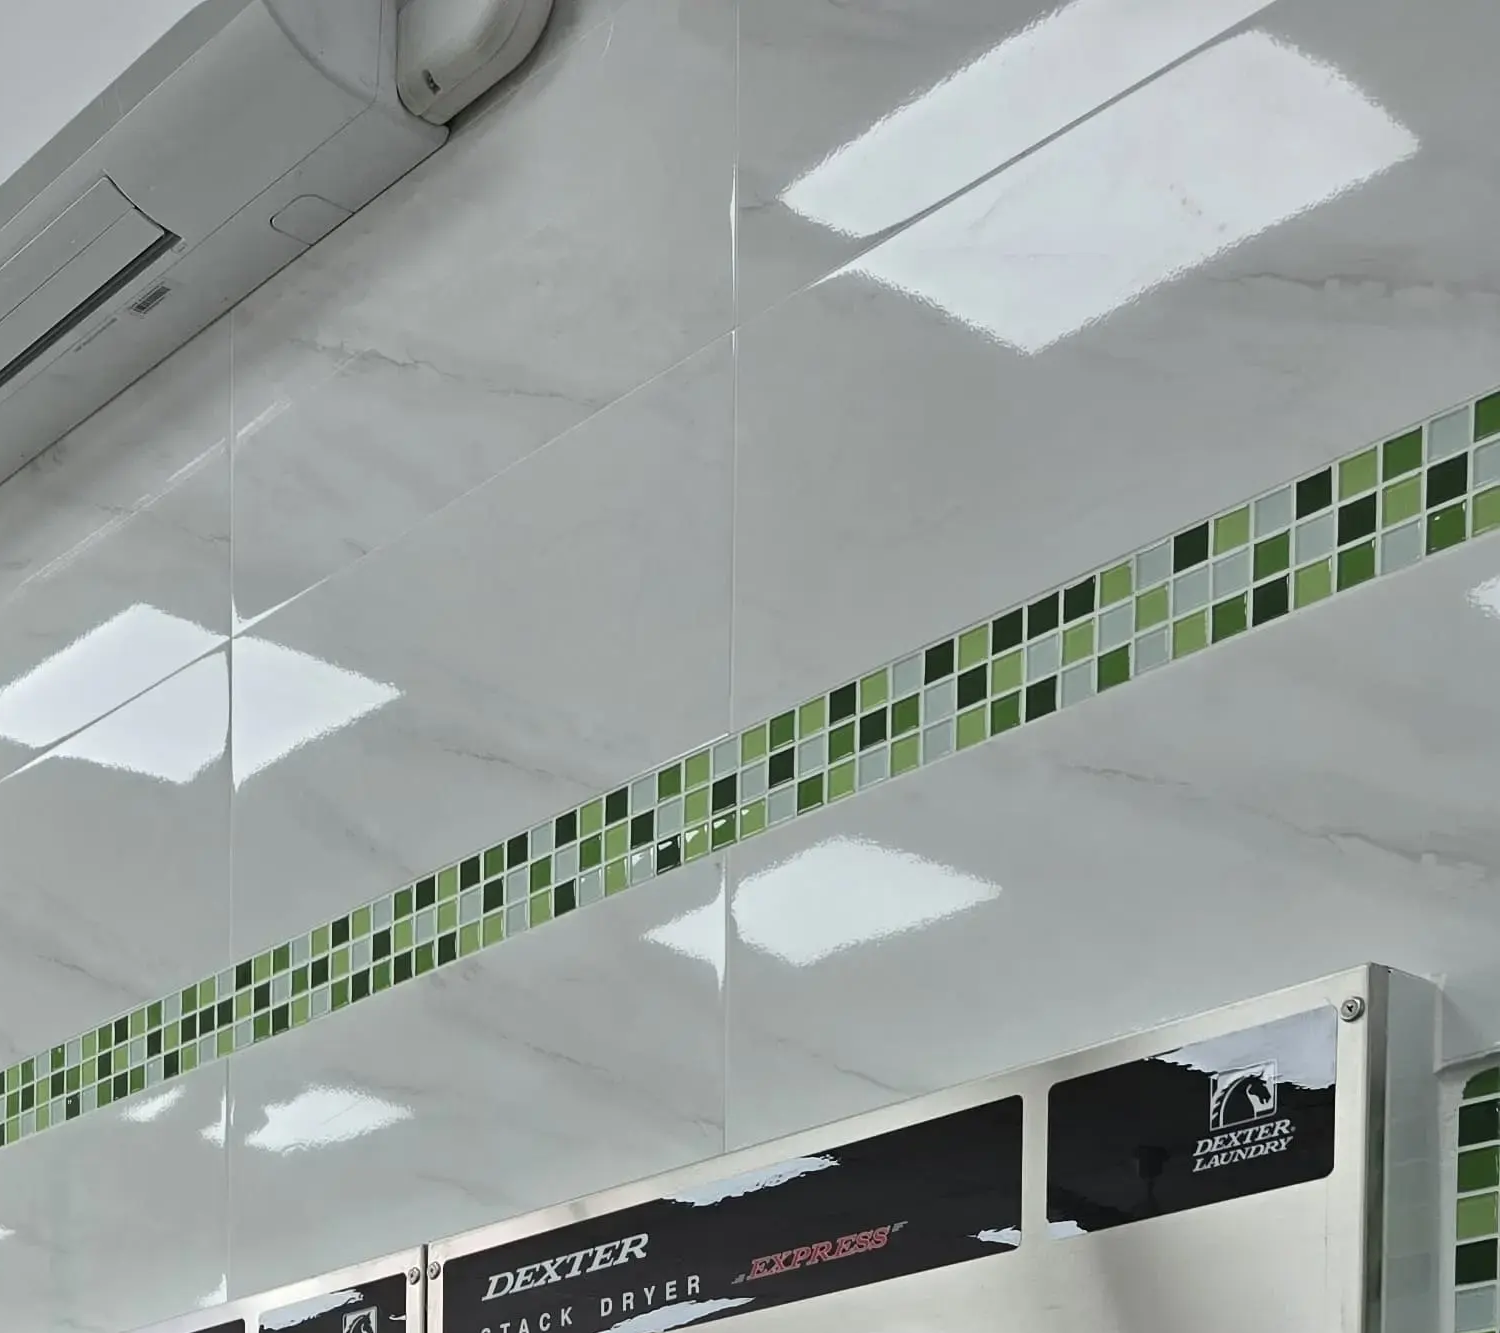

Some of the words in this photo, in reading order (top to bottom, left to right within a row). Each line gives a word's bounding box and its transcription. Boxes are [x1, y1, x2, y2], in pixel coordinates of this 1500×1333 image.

[1191, 1119, 1291, 1157] DEXTER
[1191, 1135, 1294, 1172] LAUNDRY
[481, 1233, 649, 1302] DEXTER
[745, 1225, 891, 1281] EXPRESS
[600, 1274, 701, 1317] DRYER
